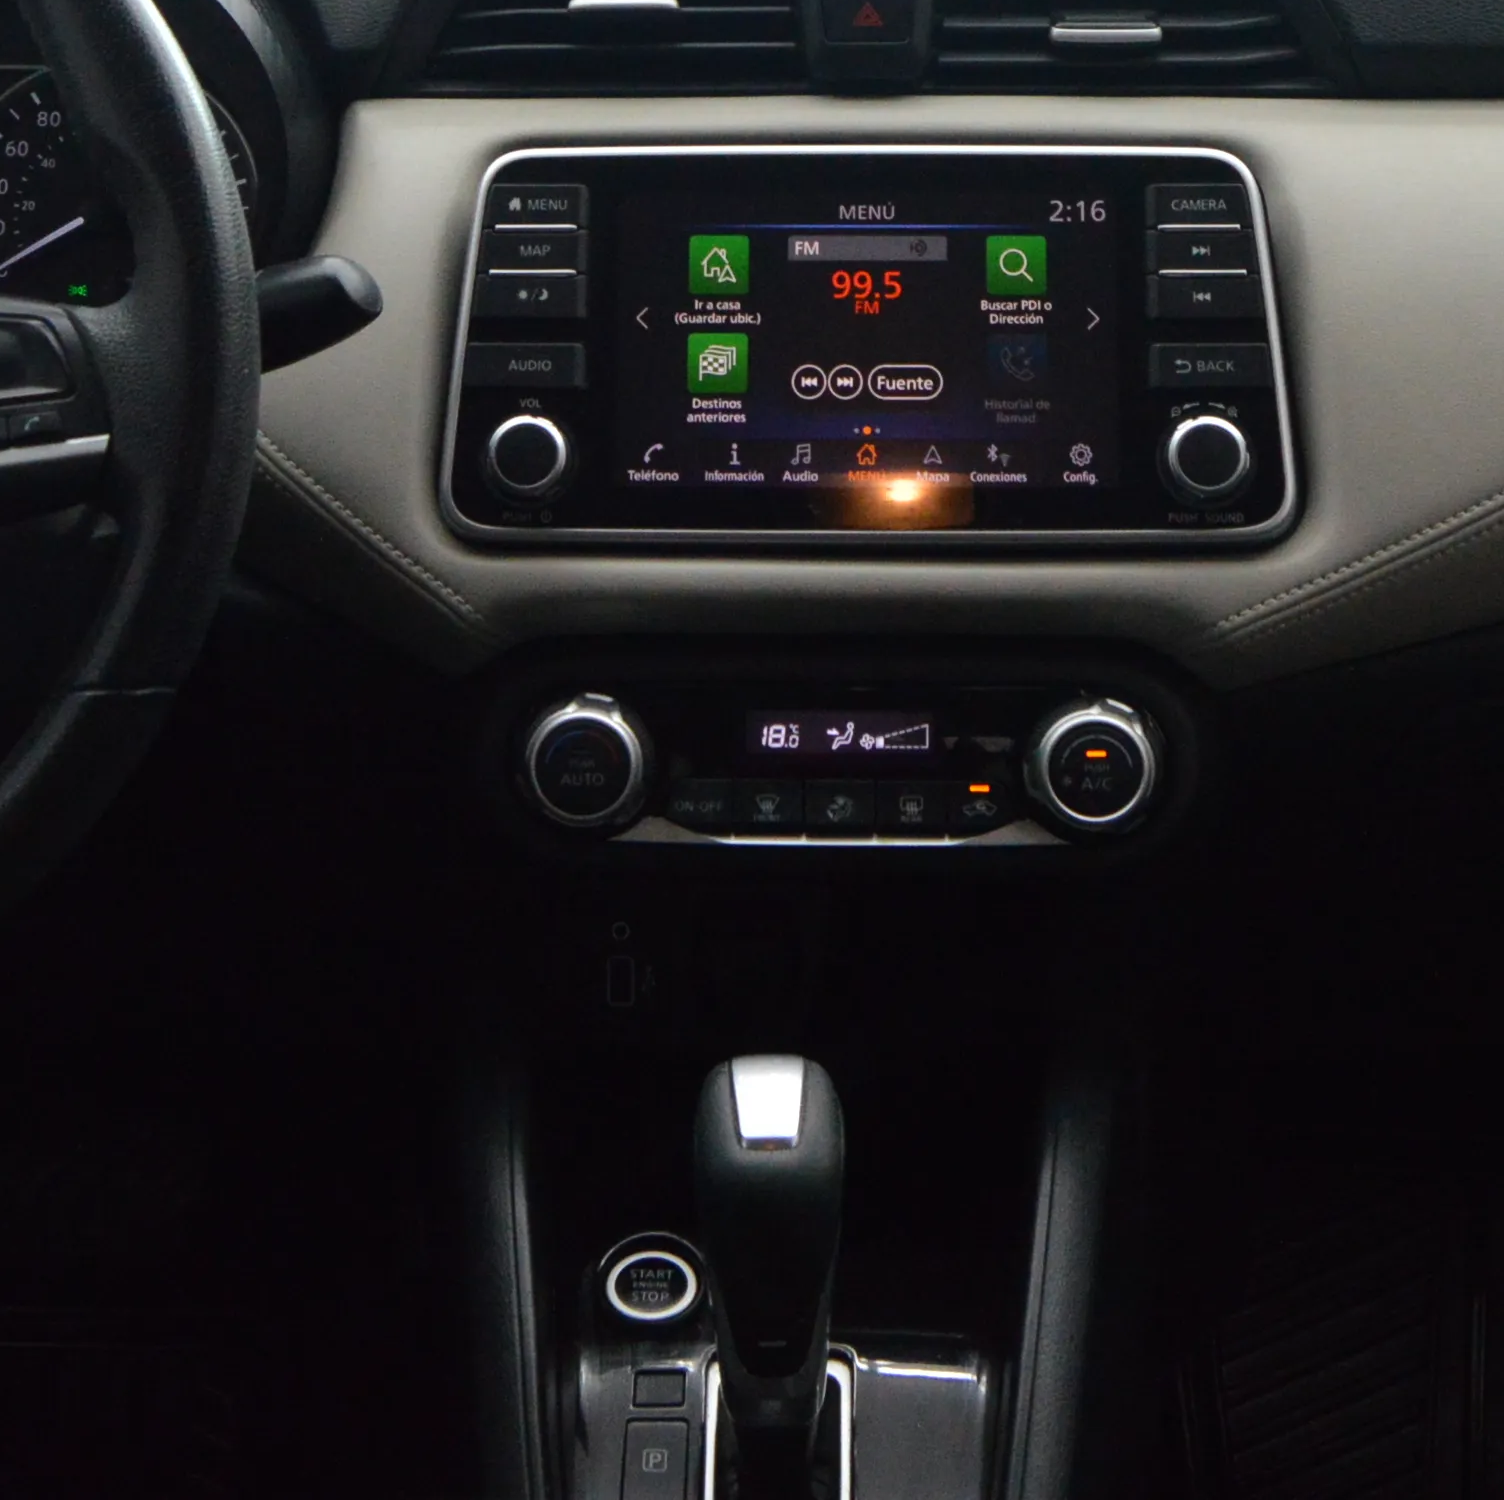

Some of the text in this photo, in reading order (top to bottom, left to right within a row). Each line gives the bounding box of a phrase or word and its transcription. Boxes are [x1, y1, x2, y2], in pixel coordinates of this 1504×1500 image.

[36, 110, 62, 128] 80
[5, 140, 29, 157] 60
[40, 158, 57, 169] 40
[21, 200, 36, 211] 20
[527, 199, 568, 211] MENU
[838, 202, 896, 220] MENÚ
[1049, 200, 1106, 222] 2:16
[1171, 199, 1227, 211] CAMERA
[520, 245, 551, 256] MAP
[794, 241, 820, 256] FM
[831, 270, 903, 299] 99.5
[694, 299, 741, 310] Ir a casa
[854, 301, 880, 314] FM
[980, 300, 1053, 311] Buscar PDI o
[674, 312, 761, 325] (Guardar ubic.)
[989, 312, 1044, 325] Dirección
[508, 359, 553, 371] AUDIO
[1196, 360, 1234, 372] BACK
[876, 375, 934, 391] Fuente
[519, 398, 542, 408] VOL
[692, 398, 742, 409] Destinos
[984, 399, 1050, 410] Historial de
[686, 412, 747, 423] anteriores
[627, 469, 679, 482] Teléfono
[704, 470, 765, 482] Información
[782, 470, 819, 482] Audio
[916, 471, 950, 484] Mapa
[970, 471, 1028, 483] Conexiones
[1063, 471, 1098, 486] Config.
[1168, 512, 1244, 523] PUSH SOUND
[560, 772, 606, 786] AUTO
[1081, 778, 1113, 792] A/C
[629, 1268, 674, 1279] START
[631, 1290, 670, 1301] STOP
